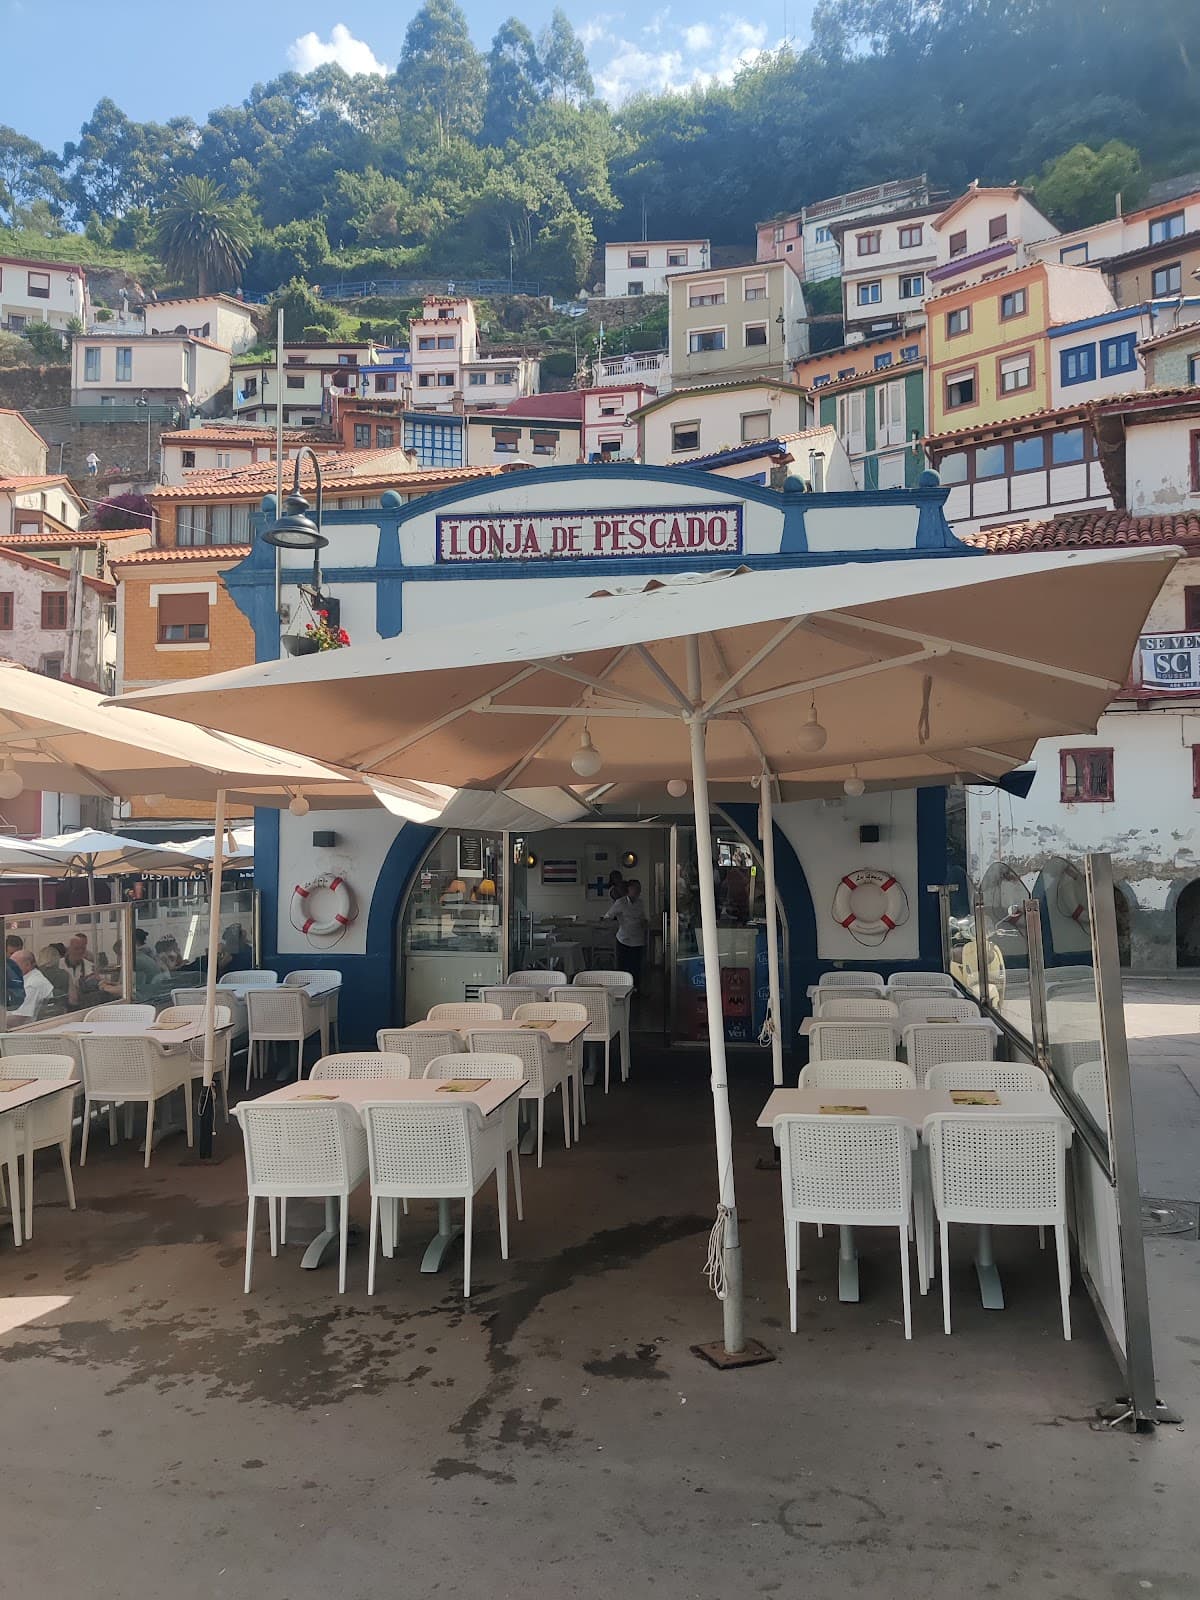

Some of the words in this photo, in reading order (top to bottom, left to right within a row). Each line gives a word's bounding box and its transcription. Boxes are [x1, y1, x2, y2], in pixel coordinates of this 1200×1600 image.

[449, 523, 541, 555] LONJA
[552, 525, 583, 553] DE
[593, 515, 728, 551] PESCADO
[1146, 638, 1166, 649] SE
[1156, 653, 1188, 673] SC
